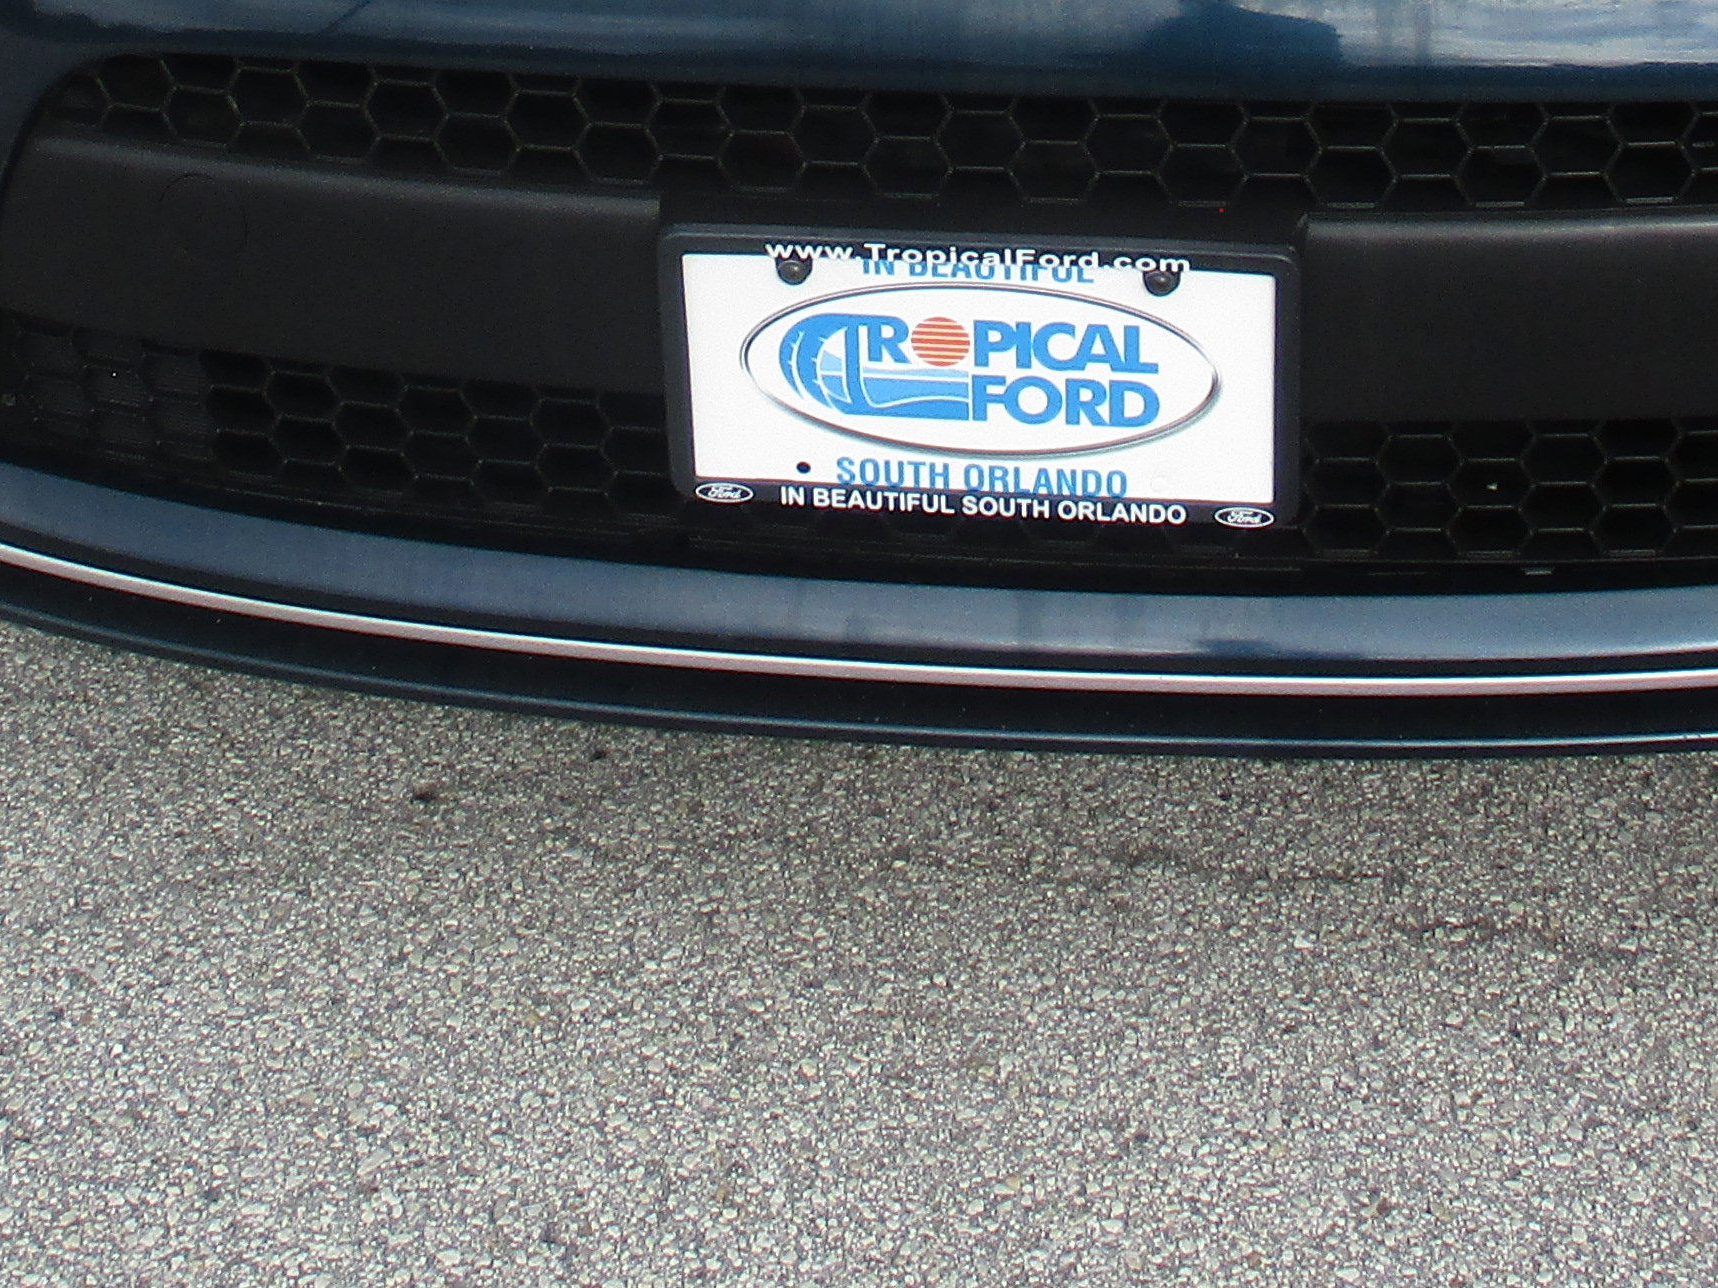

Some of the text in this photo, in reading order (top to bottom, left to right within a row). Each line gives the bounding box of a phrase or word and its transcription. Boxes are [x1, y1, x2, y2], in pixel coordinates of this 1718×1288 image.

[765, 243, 1191, 273] www.TropicalFord.com
[779, 312, 1160, 375] TROPICAL
[971, 374, 1161, 428] FORD
[836, 457, 1128, 499] SOUTH ORLANDO
[781, 486, 1187, 525] IN BEAUTIFUL SOUTH ORLANDO
